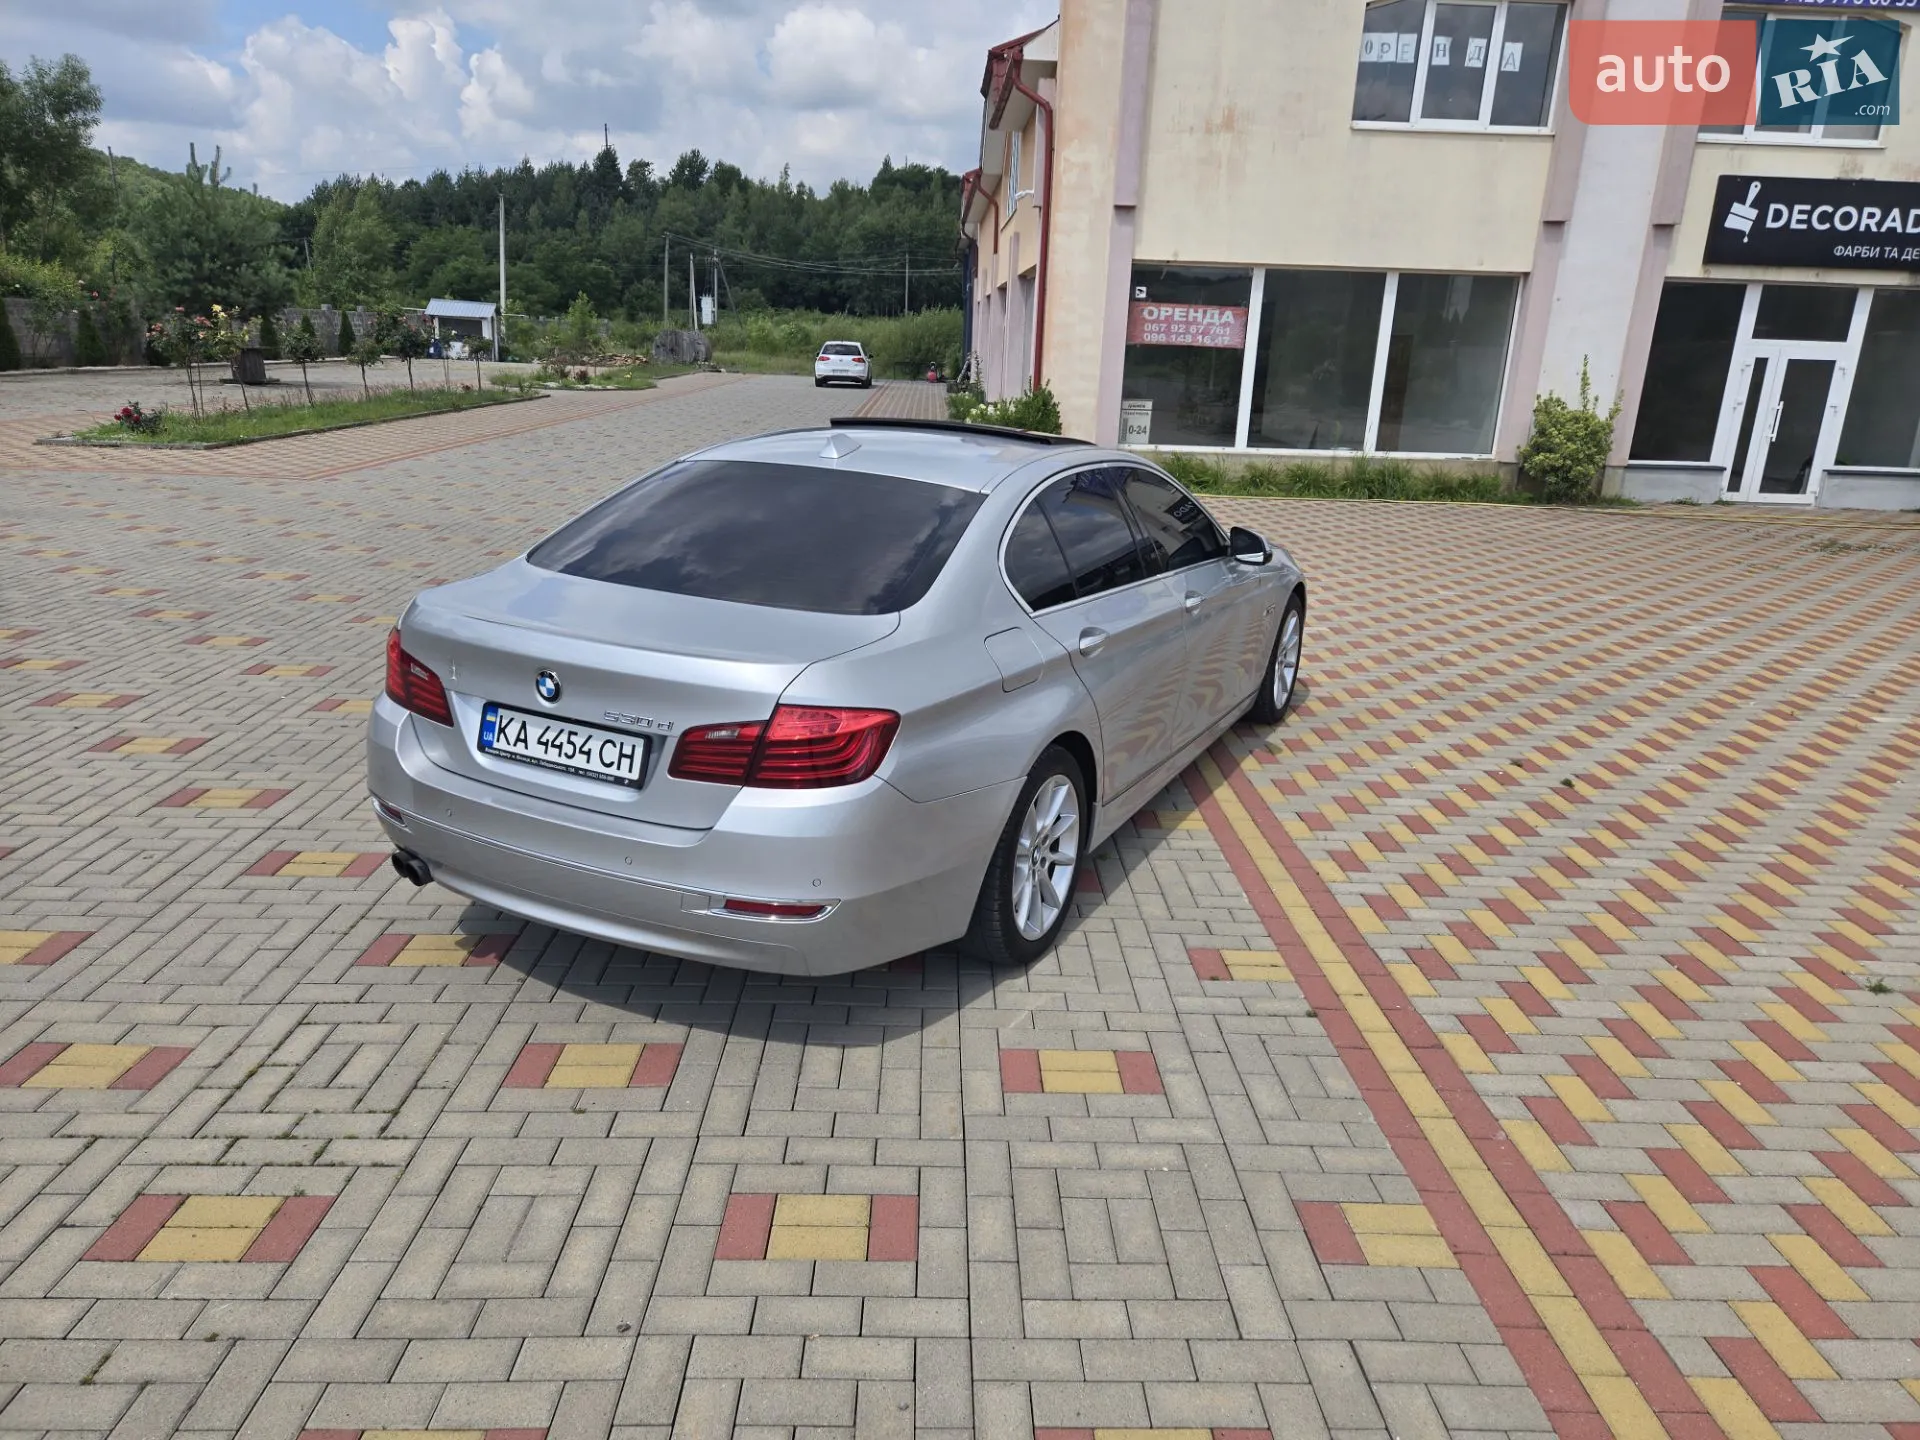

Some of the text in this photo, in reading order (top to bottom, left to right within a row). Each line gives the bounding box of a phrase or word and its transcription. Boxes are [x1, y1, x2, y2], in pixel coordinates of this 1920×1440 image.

[1833, 244, 1881, 259] ФАРБИ
[1884, 246, 1899, 260] ТА
[1143, 306, 1235, 325] ОРЕНДА
[1144, 323, 1166, 332] 067
[1171, 324, 1185, 333] 92
[1143, 333, 1166, 342] 096
[483, 731, 494, 742] UA
[496, 715, 529, 750] KA
[536, 726, 593, 764] 4454
[599, 739, 636, 774] CH
